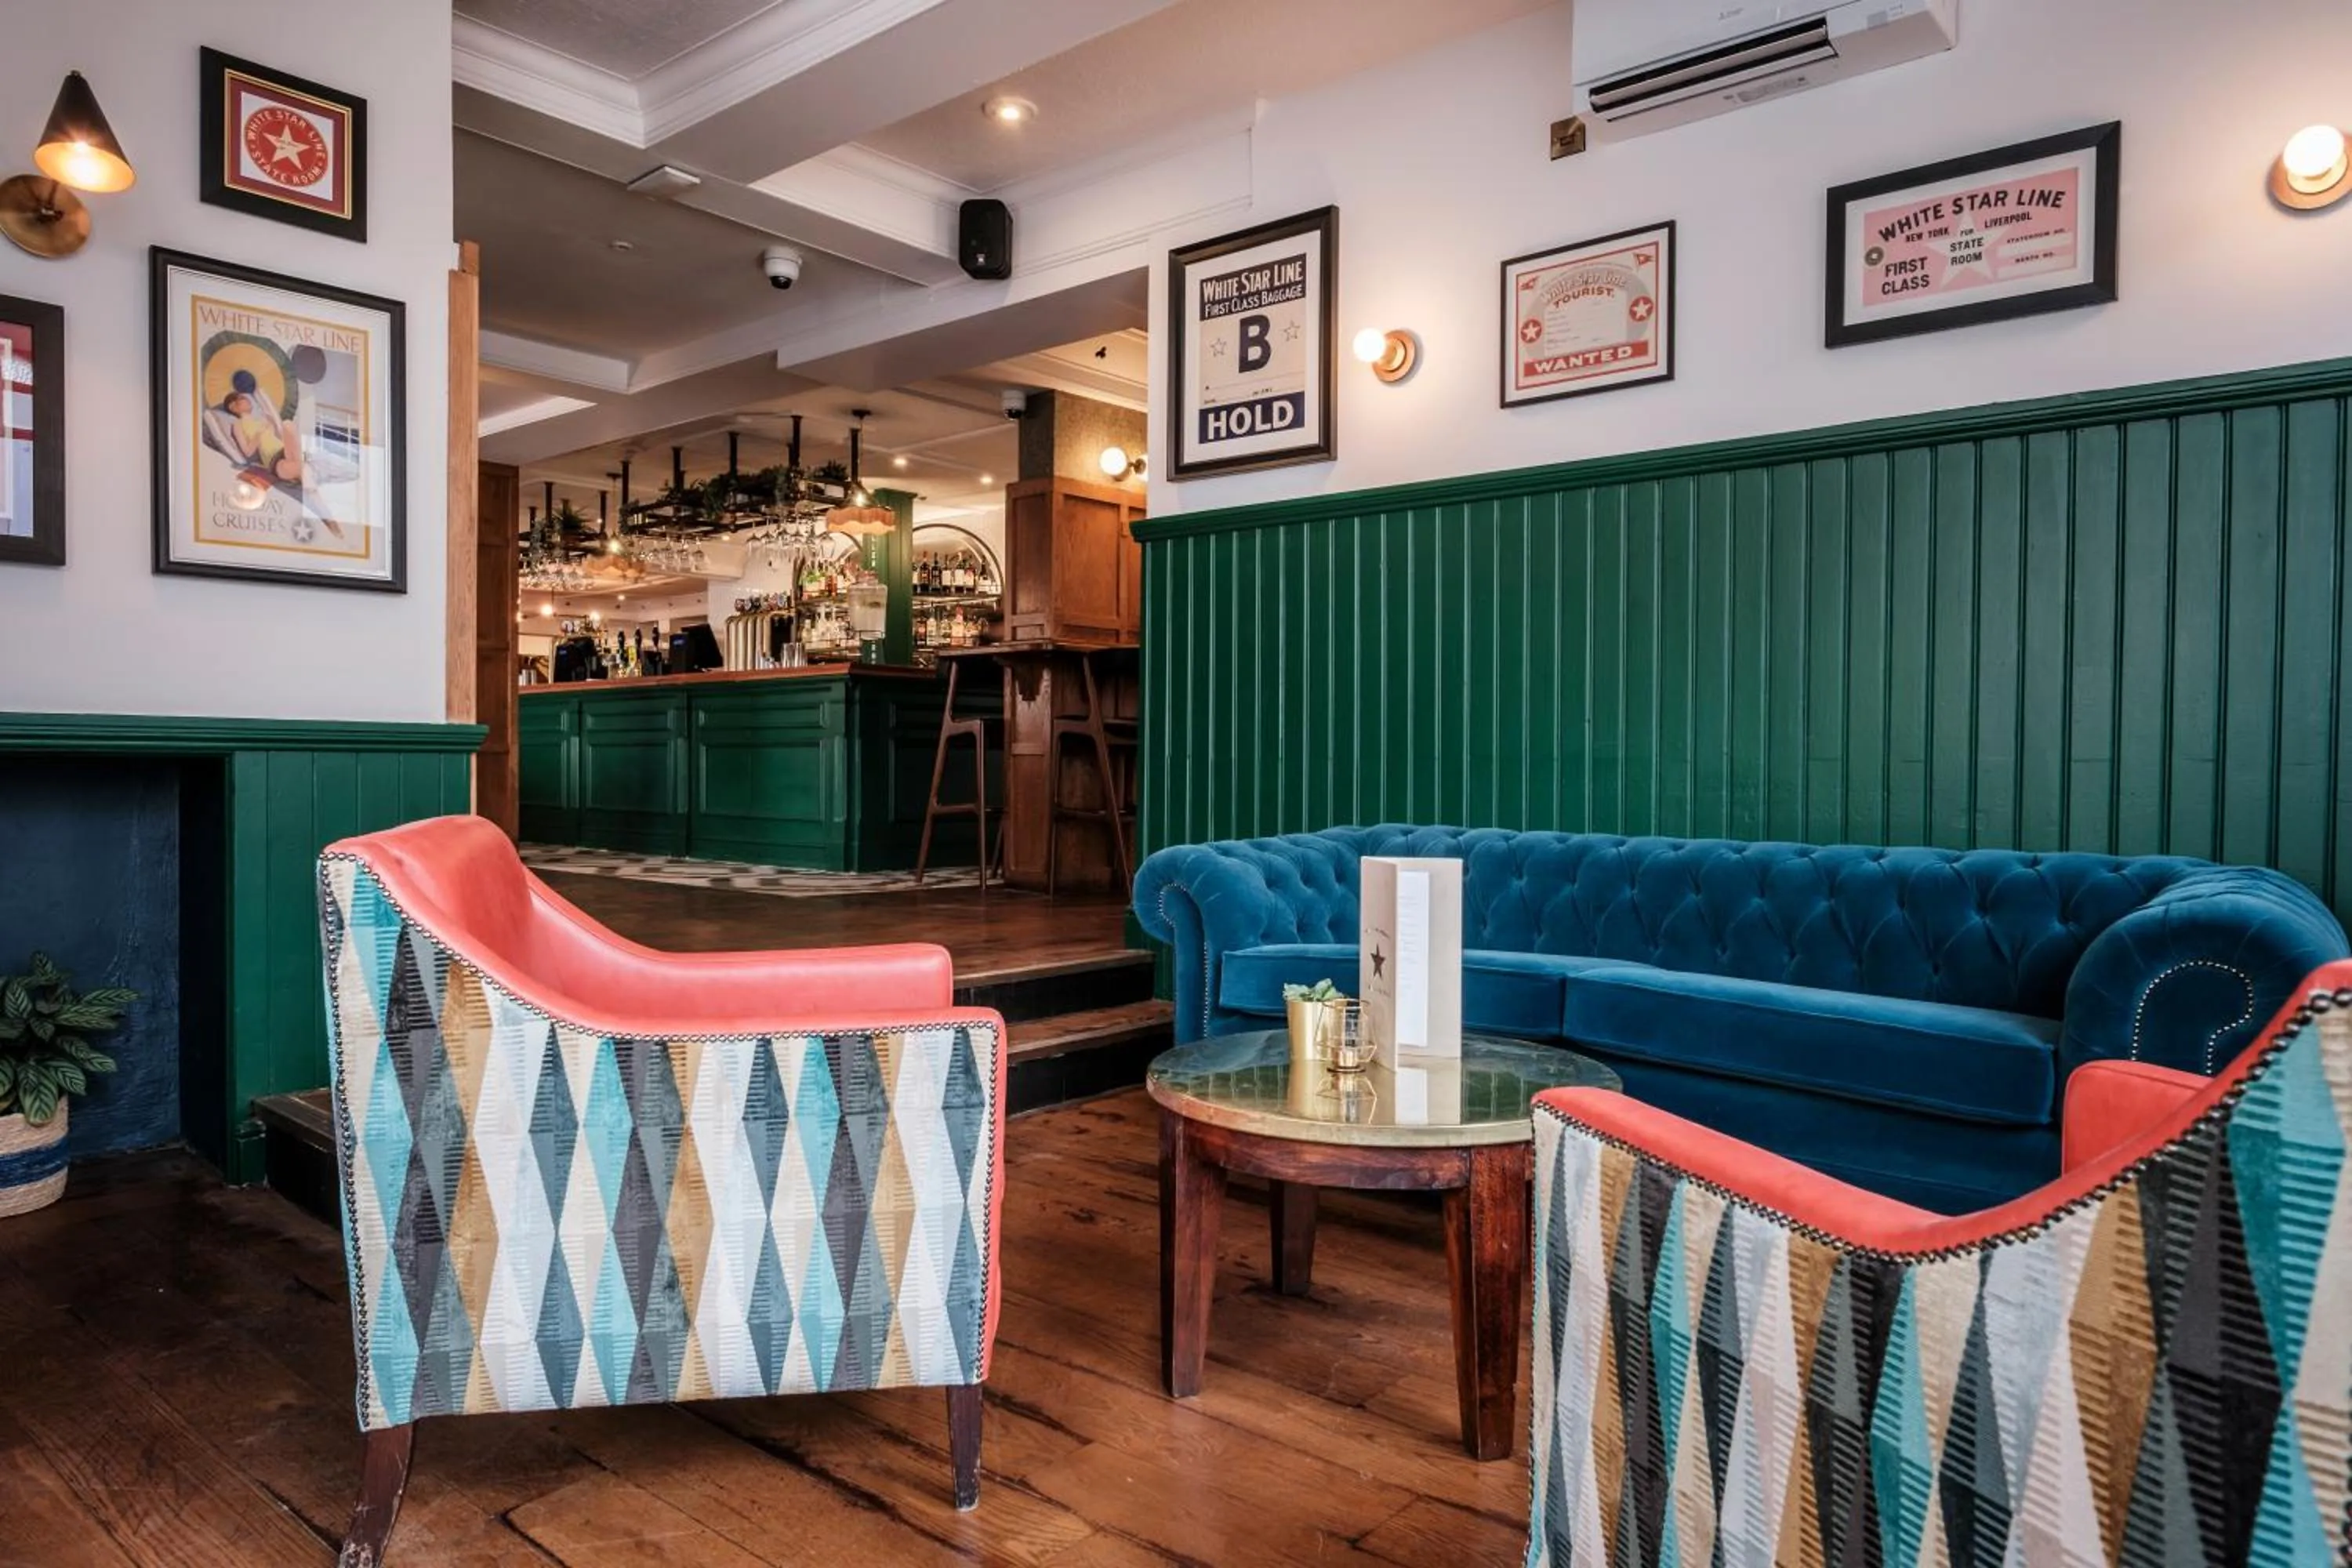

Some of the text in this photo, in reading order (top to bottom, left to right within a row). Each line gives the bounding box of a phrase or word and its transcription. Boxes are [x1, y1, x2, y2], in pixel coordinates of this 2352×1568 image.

[247, 111, 272, 140] WHITE
[276, 111, 307, 129] STAR
[308, 131, 326, 159] LINE
[252, 151, 321, 183] STATE ROOM
[1878, 189, 2066, 242] WHITE STAR LINE
[1984, 211, 2033, 228] LIVERPOOL
[1950, 237, 1984, 252] STATE
[1950, 251, 1983, 266] ROOM
[1203, 261, 1304, 303] WHITE STAR LINE
[1884, 256, 1929, 278] FIRST
[1882, 274, 1931, 296] CLASS
[199, 305, 361, 353] WHITE STAR LINE
[1238, 314, 1272, 373] B
[1534, 346, 1633, 374] WANTED
[1208, 400, 1294, 440] HOLD
[212, 512, 287, 532] CRUISES
